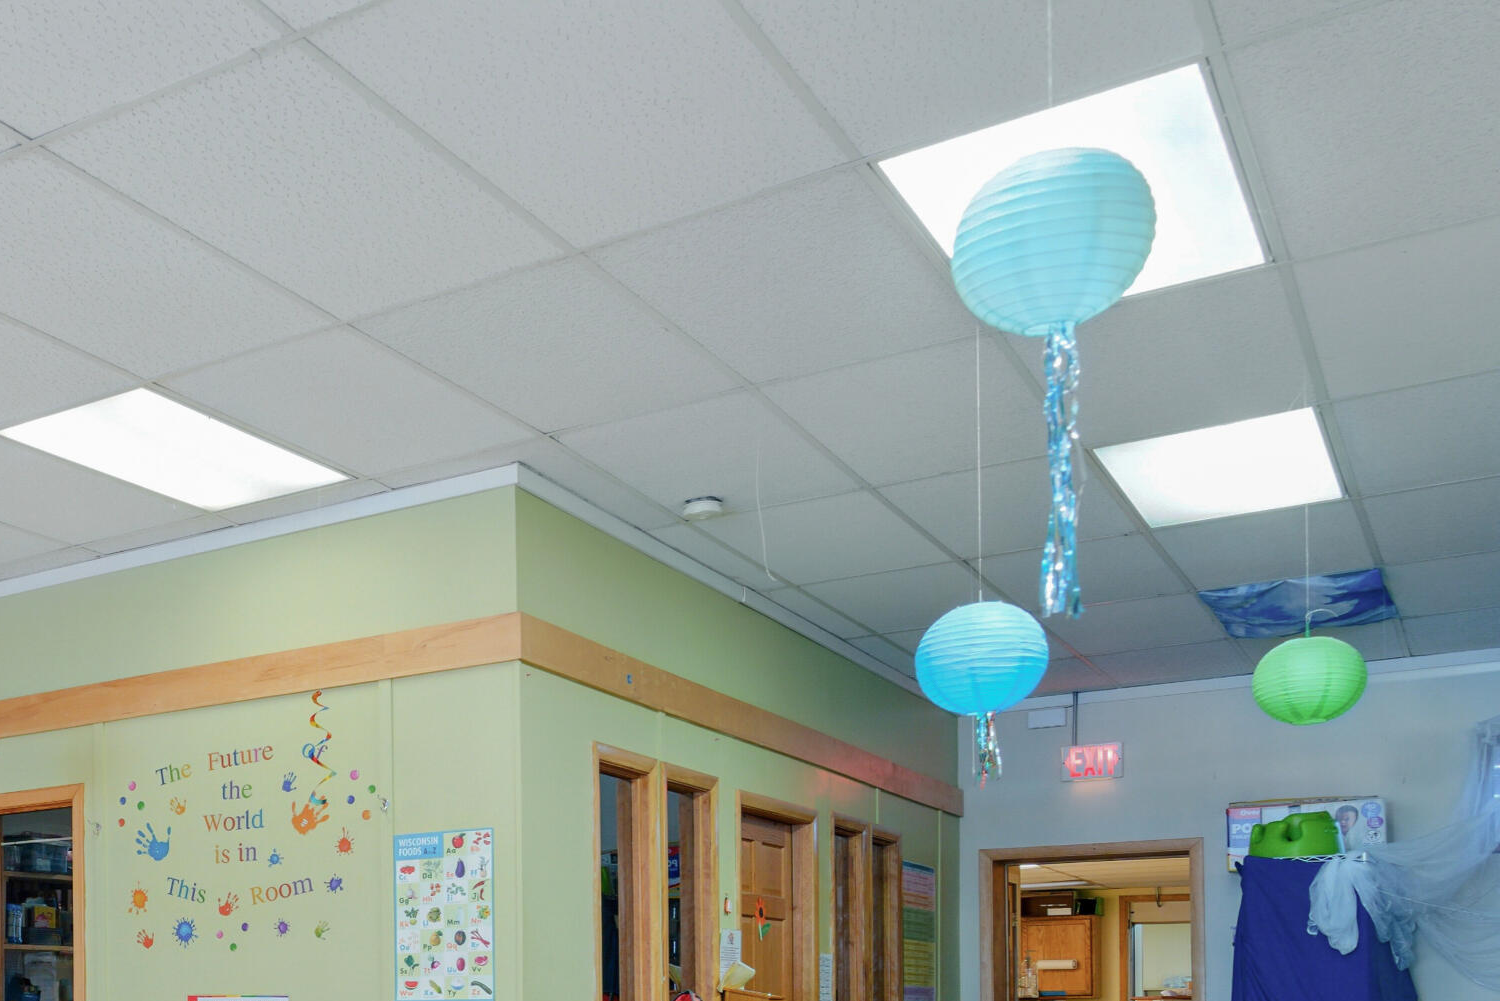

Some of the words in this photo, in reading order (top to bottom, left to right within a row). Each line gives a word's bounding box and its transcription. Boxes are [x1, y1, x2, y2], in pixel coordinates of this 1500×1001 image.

[155, 761, 192, 786] The
[207, 742, 274, 771] Future
[1068, 744, 1118, 778] EXIT
[221, 780, 253, 800] the
[203, 808, 265, 833] World
[215, 844, 231, 864] is
[238, 841, 257, 863] in
[398, 836, 438, 847] WISCONSIN
[398, 847, 421, 857] FOODS
[166, 877, 206, 904] This
[249, 875, 314, 906] Room
